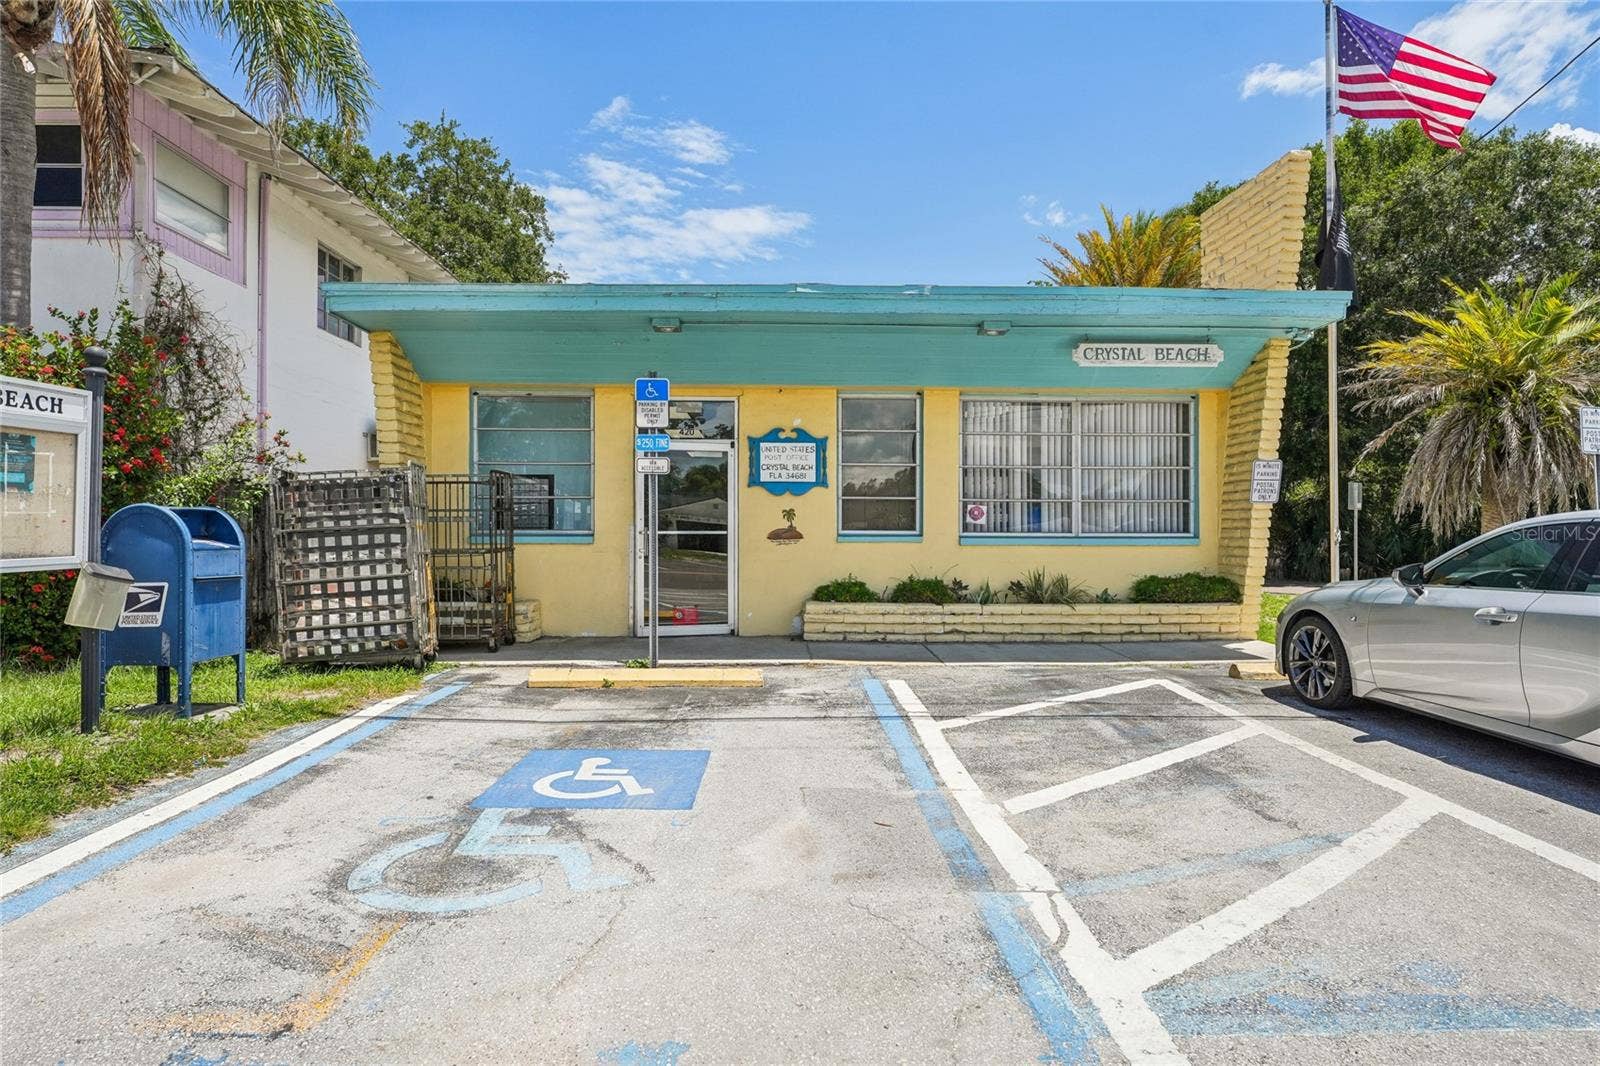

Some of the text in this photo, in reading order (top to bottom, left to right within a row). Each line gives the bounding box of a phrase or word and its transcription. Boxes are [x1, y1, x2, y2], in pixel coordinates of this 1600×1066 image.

[1083, 347, 1209, 362] CRYSTAL BEACH
[0, 389, 63, 414] EACH
[636, 438, 668, 448] $250 FINE
